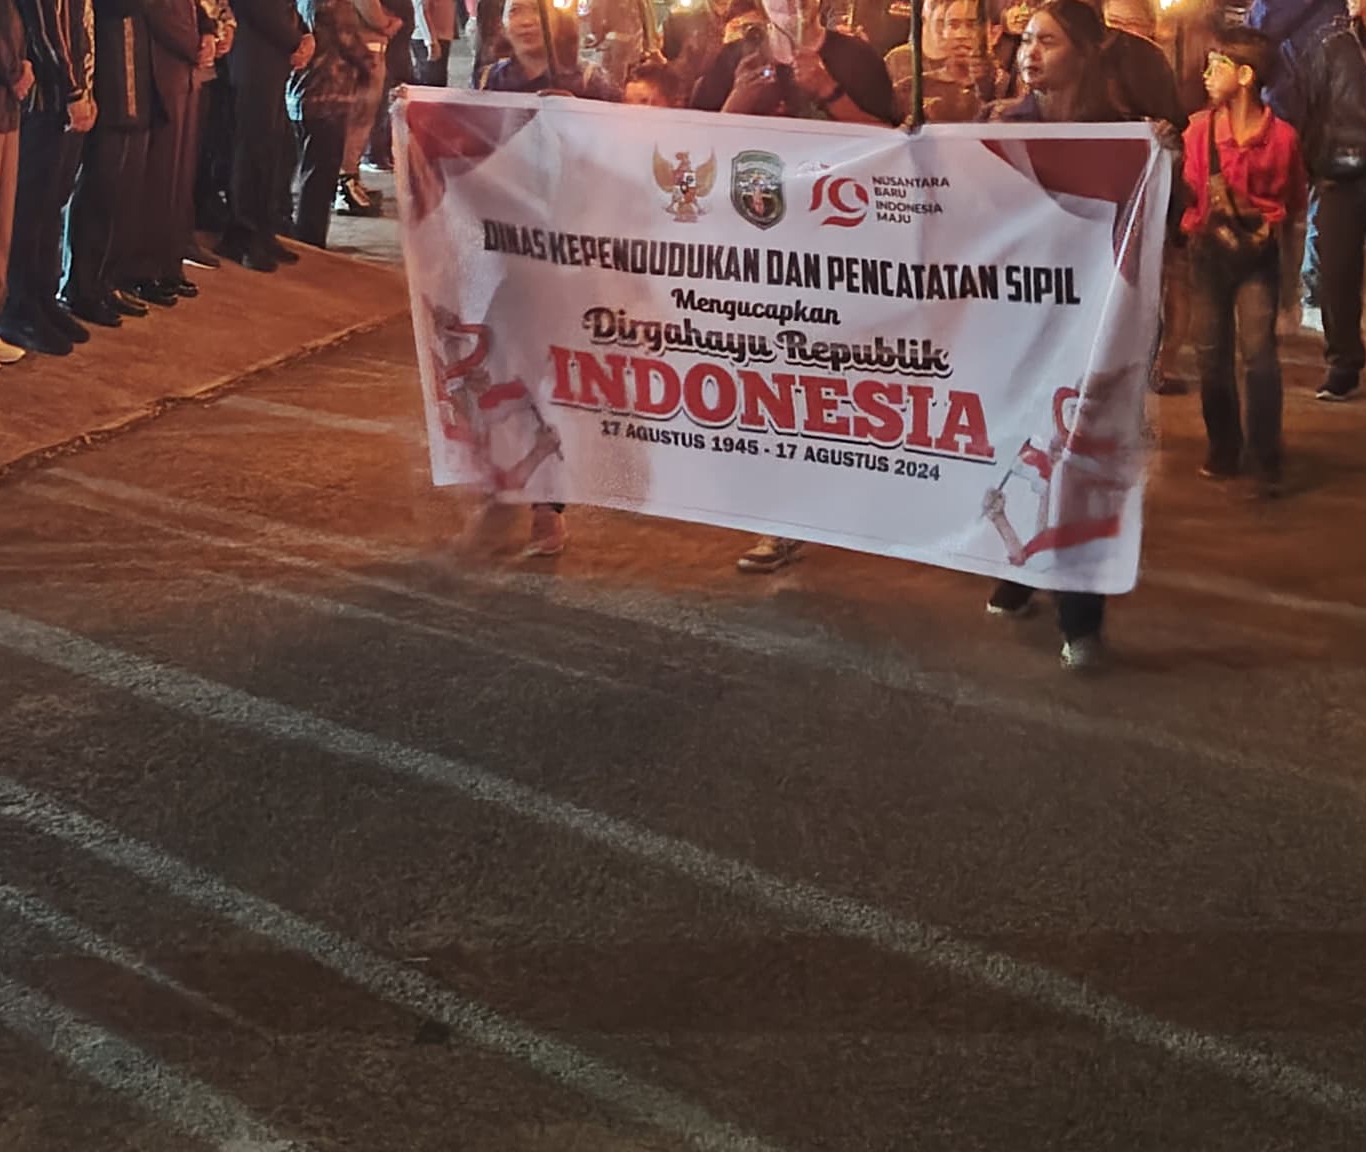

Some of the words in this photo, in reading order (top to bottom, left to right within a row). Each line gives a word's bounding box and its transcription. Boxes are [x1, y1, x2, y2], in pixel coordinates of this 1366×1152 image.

[872, 176, 950, 188] NUSANTARA
[874, 187, 907, 198] BARU
[876, 200, 943, 215] INDONESIA
[876, 212, 911, 224] MAJU
[483, 219, 547, 261] DINAS
[548, 231, 761, 284] KEPENDUDUKAN
[767, 248, 821, 290] DAN
[827, 255, 999, 301] PENCATATAN
[1005, 264, 1081, 305] SIPIL
[670, 287, 841, 327] Mengucapkan
[583, 306, 774, 363] Dirgahayu
[774, 329, 953, 376] Republik
[548, 345, 997, 463] INDONESIA
[600, 419, 621, 437] 17
[625, 423, 706, 449] AGUSTUS
[711, 436, 759, 455] 1945
[776, 442, 797, 460] 17
[803, 448, 889, 473] AGUSTUS
[893, 459, 941, 481] 2024
